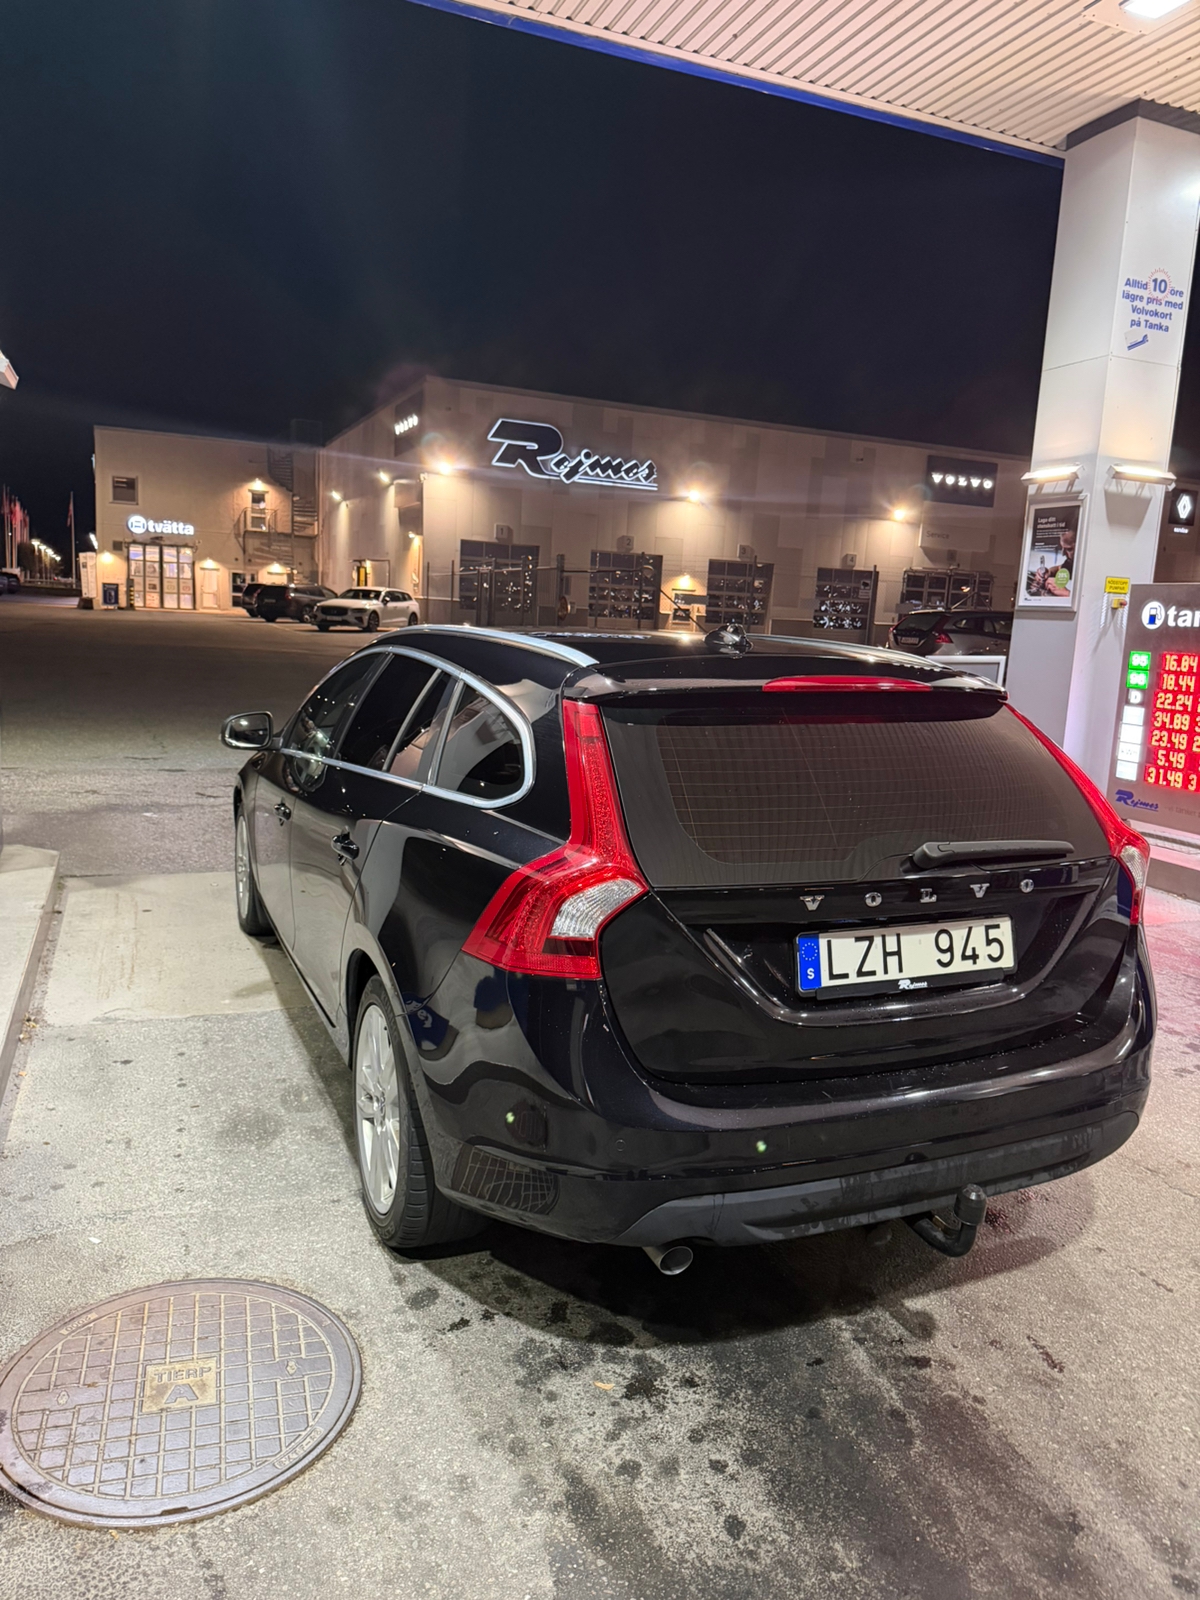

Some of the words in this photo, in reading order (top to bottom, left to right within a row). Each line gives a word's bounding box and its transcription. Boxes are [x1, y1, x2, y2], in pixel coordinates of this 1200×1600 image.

[1124, 278, 1148, 290] Alltid
[1152, 278, 1167, 294] 10
[1170, 286, 1184, 297] öre
[1122, 290, 1144, 302] lägre
[1146, 297, 1162, 306] pris
[1164, 300, 1184, 310] med
[1131, 304, 1172, 320] Volvokort
[1130, 317, 1141, 328] på
[1144, 320, 1169, 332] Tanka
[932, 472, 993, 489] VOLVO
[147, 520, 195, 535] tvätta
[926, 530, 950, 540] Service
[1132, 654, 1148, 667] 95
[1165, 654, 1198, 673] 16.84
[1162, 674, 1195, 692] 18.44
[1130, 690, 1142, 704] D
[1156, 692, 1193, 712] 22.24
[1154, 711, 1190, 730] 34.89
[1151, 730, 1188, 750] 23.49
[1157, 750, 1186, 769] 5.49
[800, 878, 1034, 911] VOLVO
[807, 968, 815, 980] S
[826, 933, 903, 980] LZH
[934, 924, 1004, 968] 945
[154, 1366, 211, 1383] TIERP
[164, 1383, 198, 1404] A
